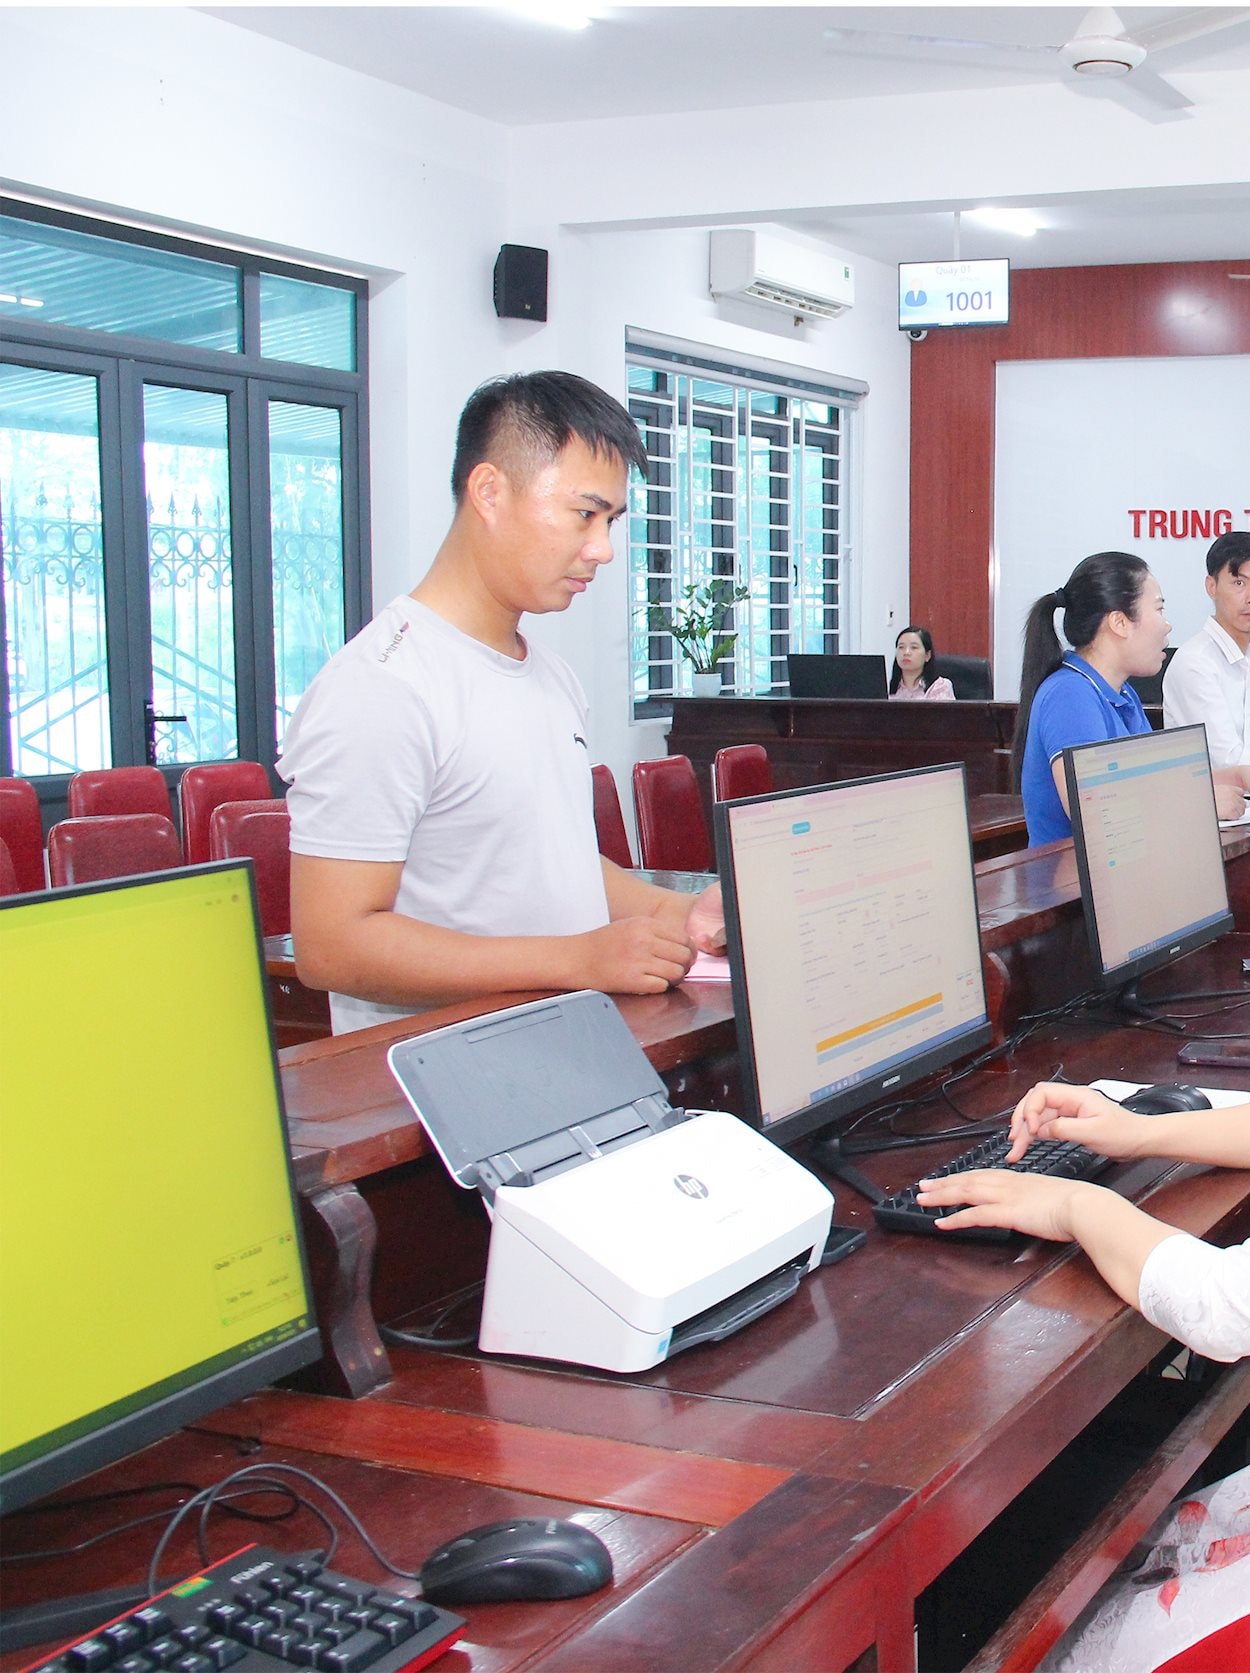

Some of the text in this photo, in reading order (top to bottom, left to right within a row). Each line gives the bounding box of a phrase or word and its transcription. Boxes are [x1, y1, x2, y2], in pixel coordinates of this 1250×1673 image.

[946, 290, 992, 311] 1001
[1127, 508, 1232, 540] TRUNG
[673, 1174, 709, 1199] hp
